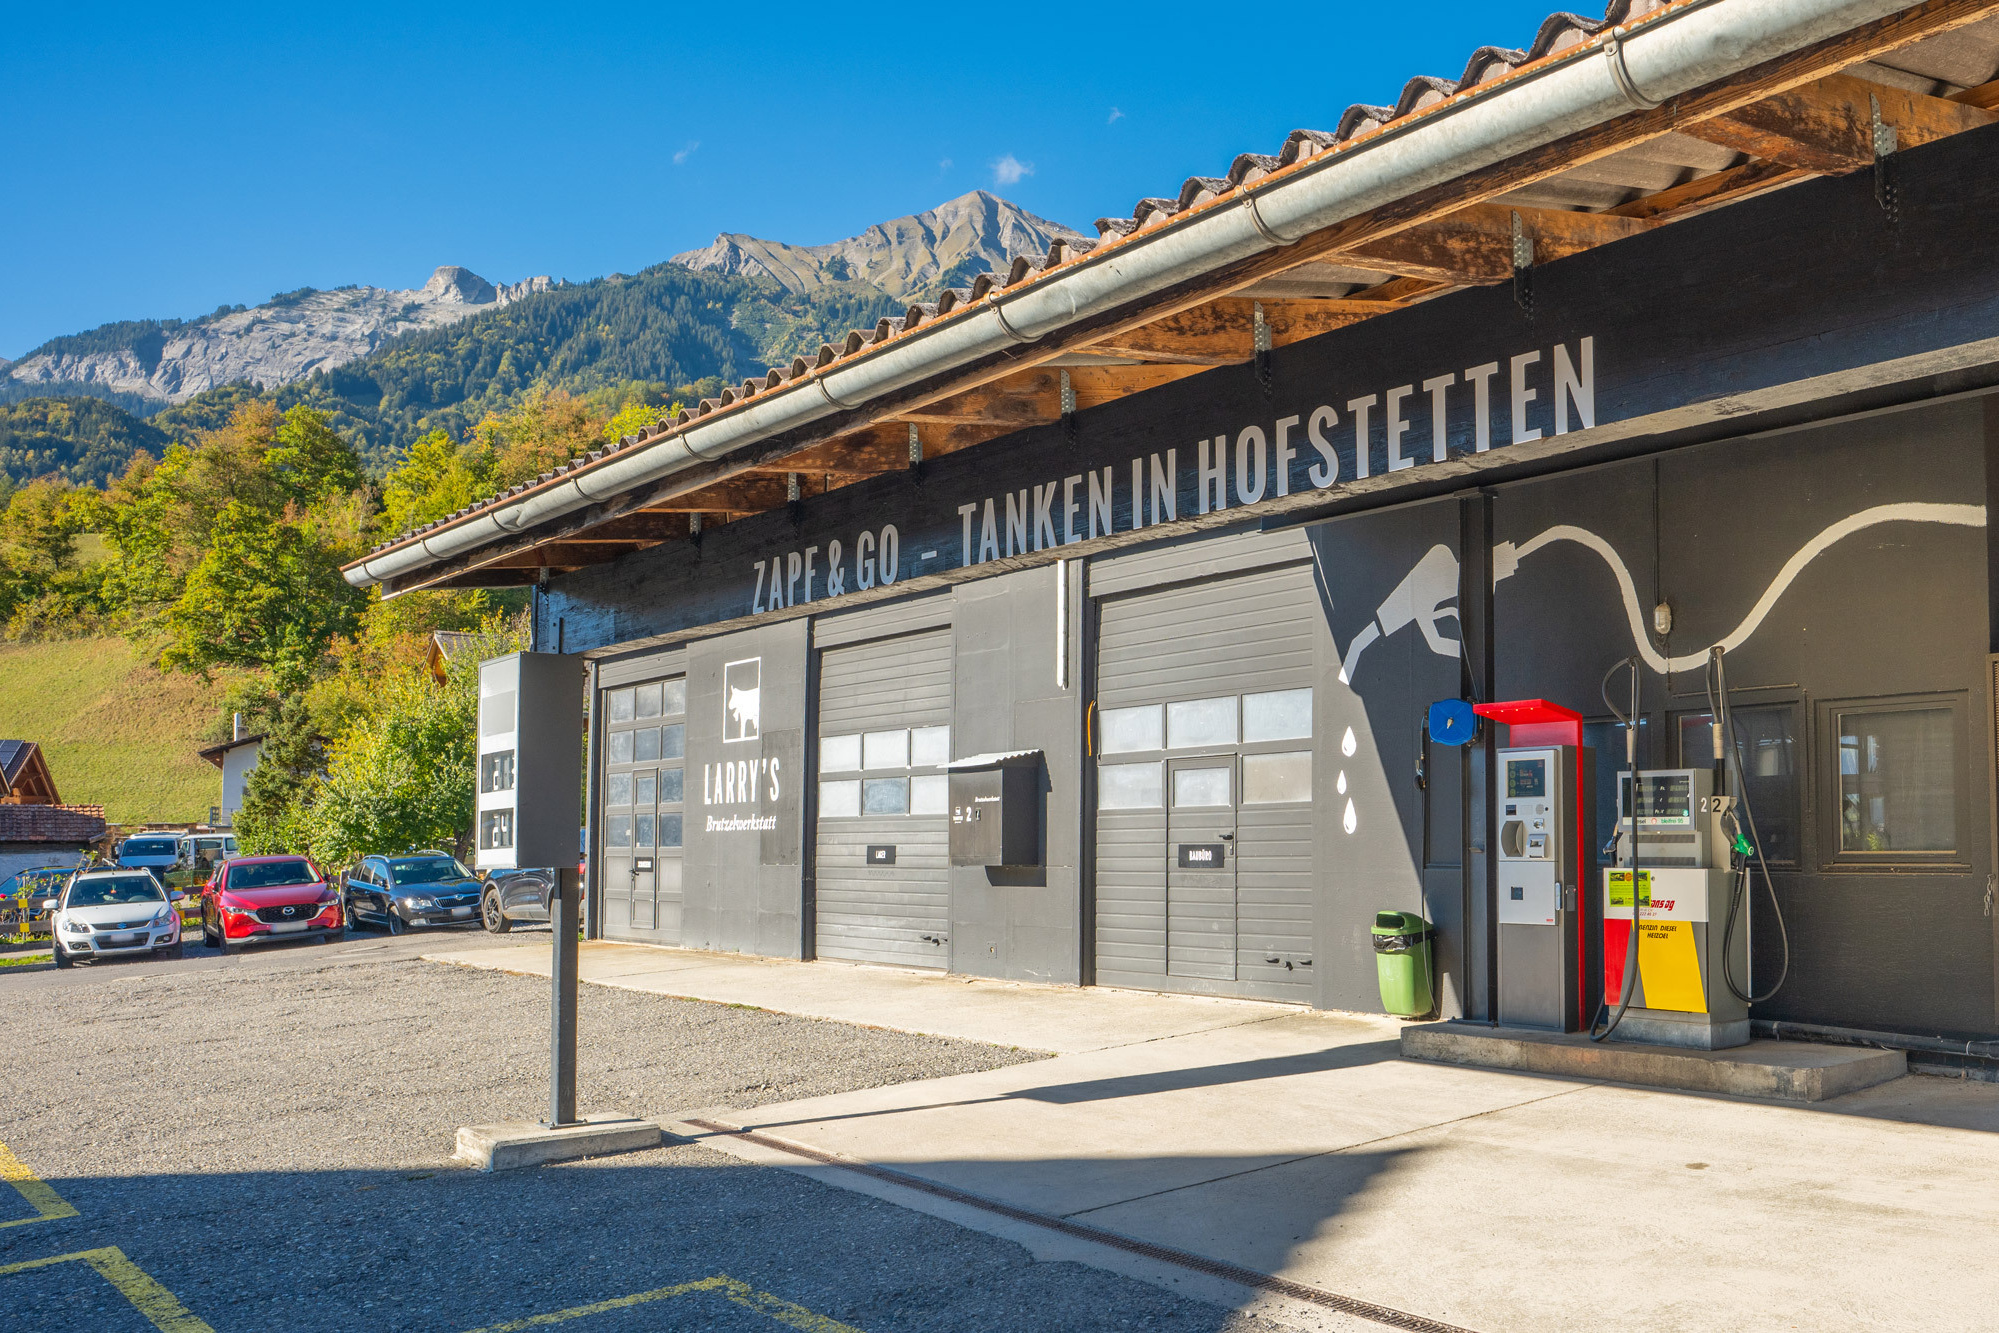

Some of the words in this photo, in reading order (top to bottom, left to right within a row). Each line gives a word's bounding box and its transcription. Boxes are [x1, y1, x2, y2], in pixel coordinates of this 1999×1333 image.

[752, 546, 818, 615] ZAPF
[827, 539, 845, 597] &
[856, 524, 899, 591] GO
[957, 465, 1113, 567] TANKEN
[1132, 448, 1177, 530] IN
[1198, 335, 1595, 515] HOFSTETTEN
[704, 757, 780, 805] LARRY'S
[1700, 797, 1707, 812] 2
[1712, 798, 1721, 812] 2
[966, 806, 971, 822] 2
[705, 814, 777, 832] Brutzelwerkstatt
